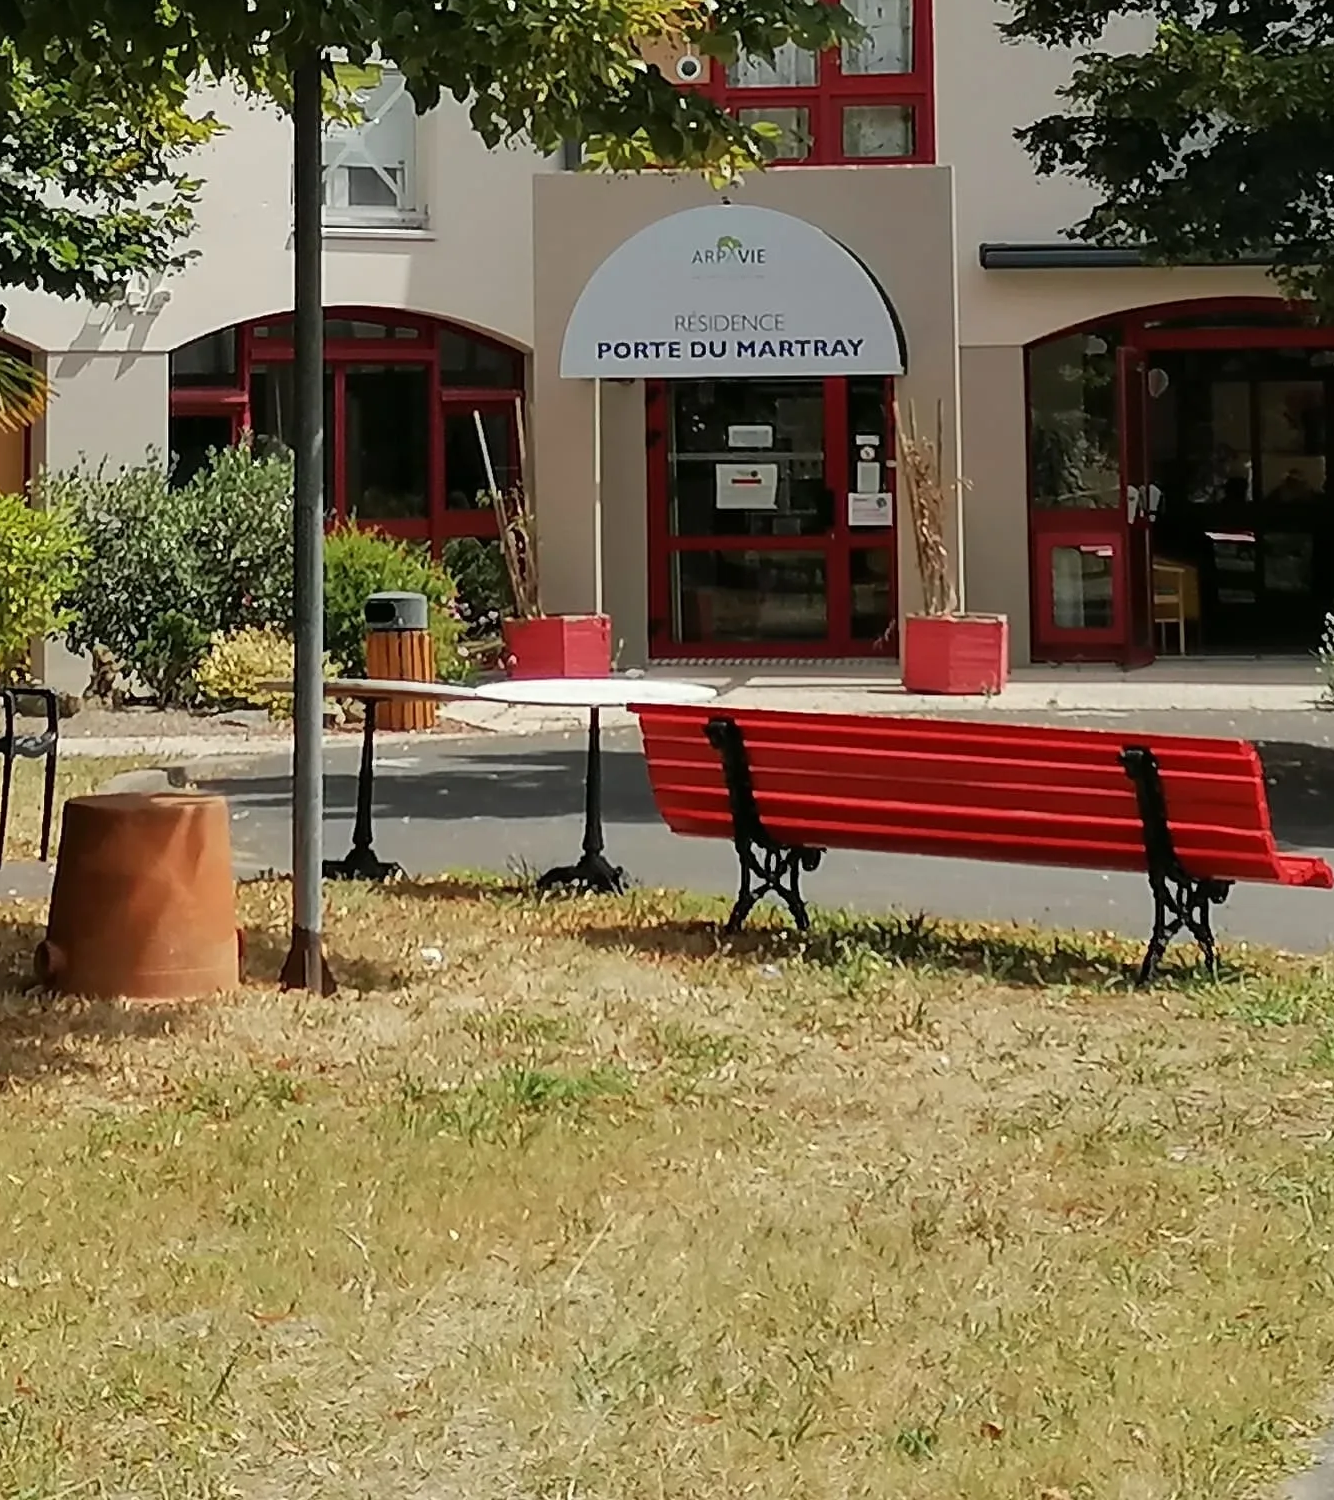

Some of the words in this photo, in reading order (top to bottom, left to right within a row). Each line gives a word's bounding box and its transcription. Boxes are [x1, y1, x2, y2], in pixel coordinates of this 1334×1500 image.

[674, 312, 785, 332] RÉSIDENCE
[597, 341, 681, 359] PORTE
[690, 341, 727, 358] DU
[736, 339, 864, 358] MARTRAY
